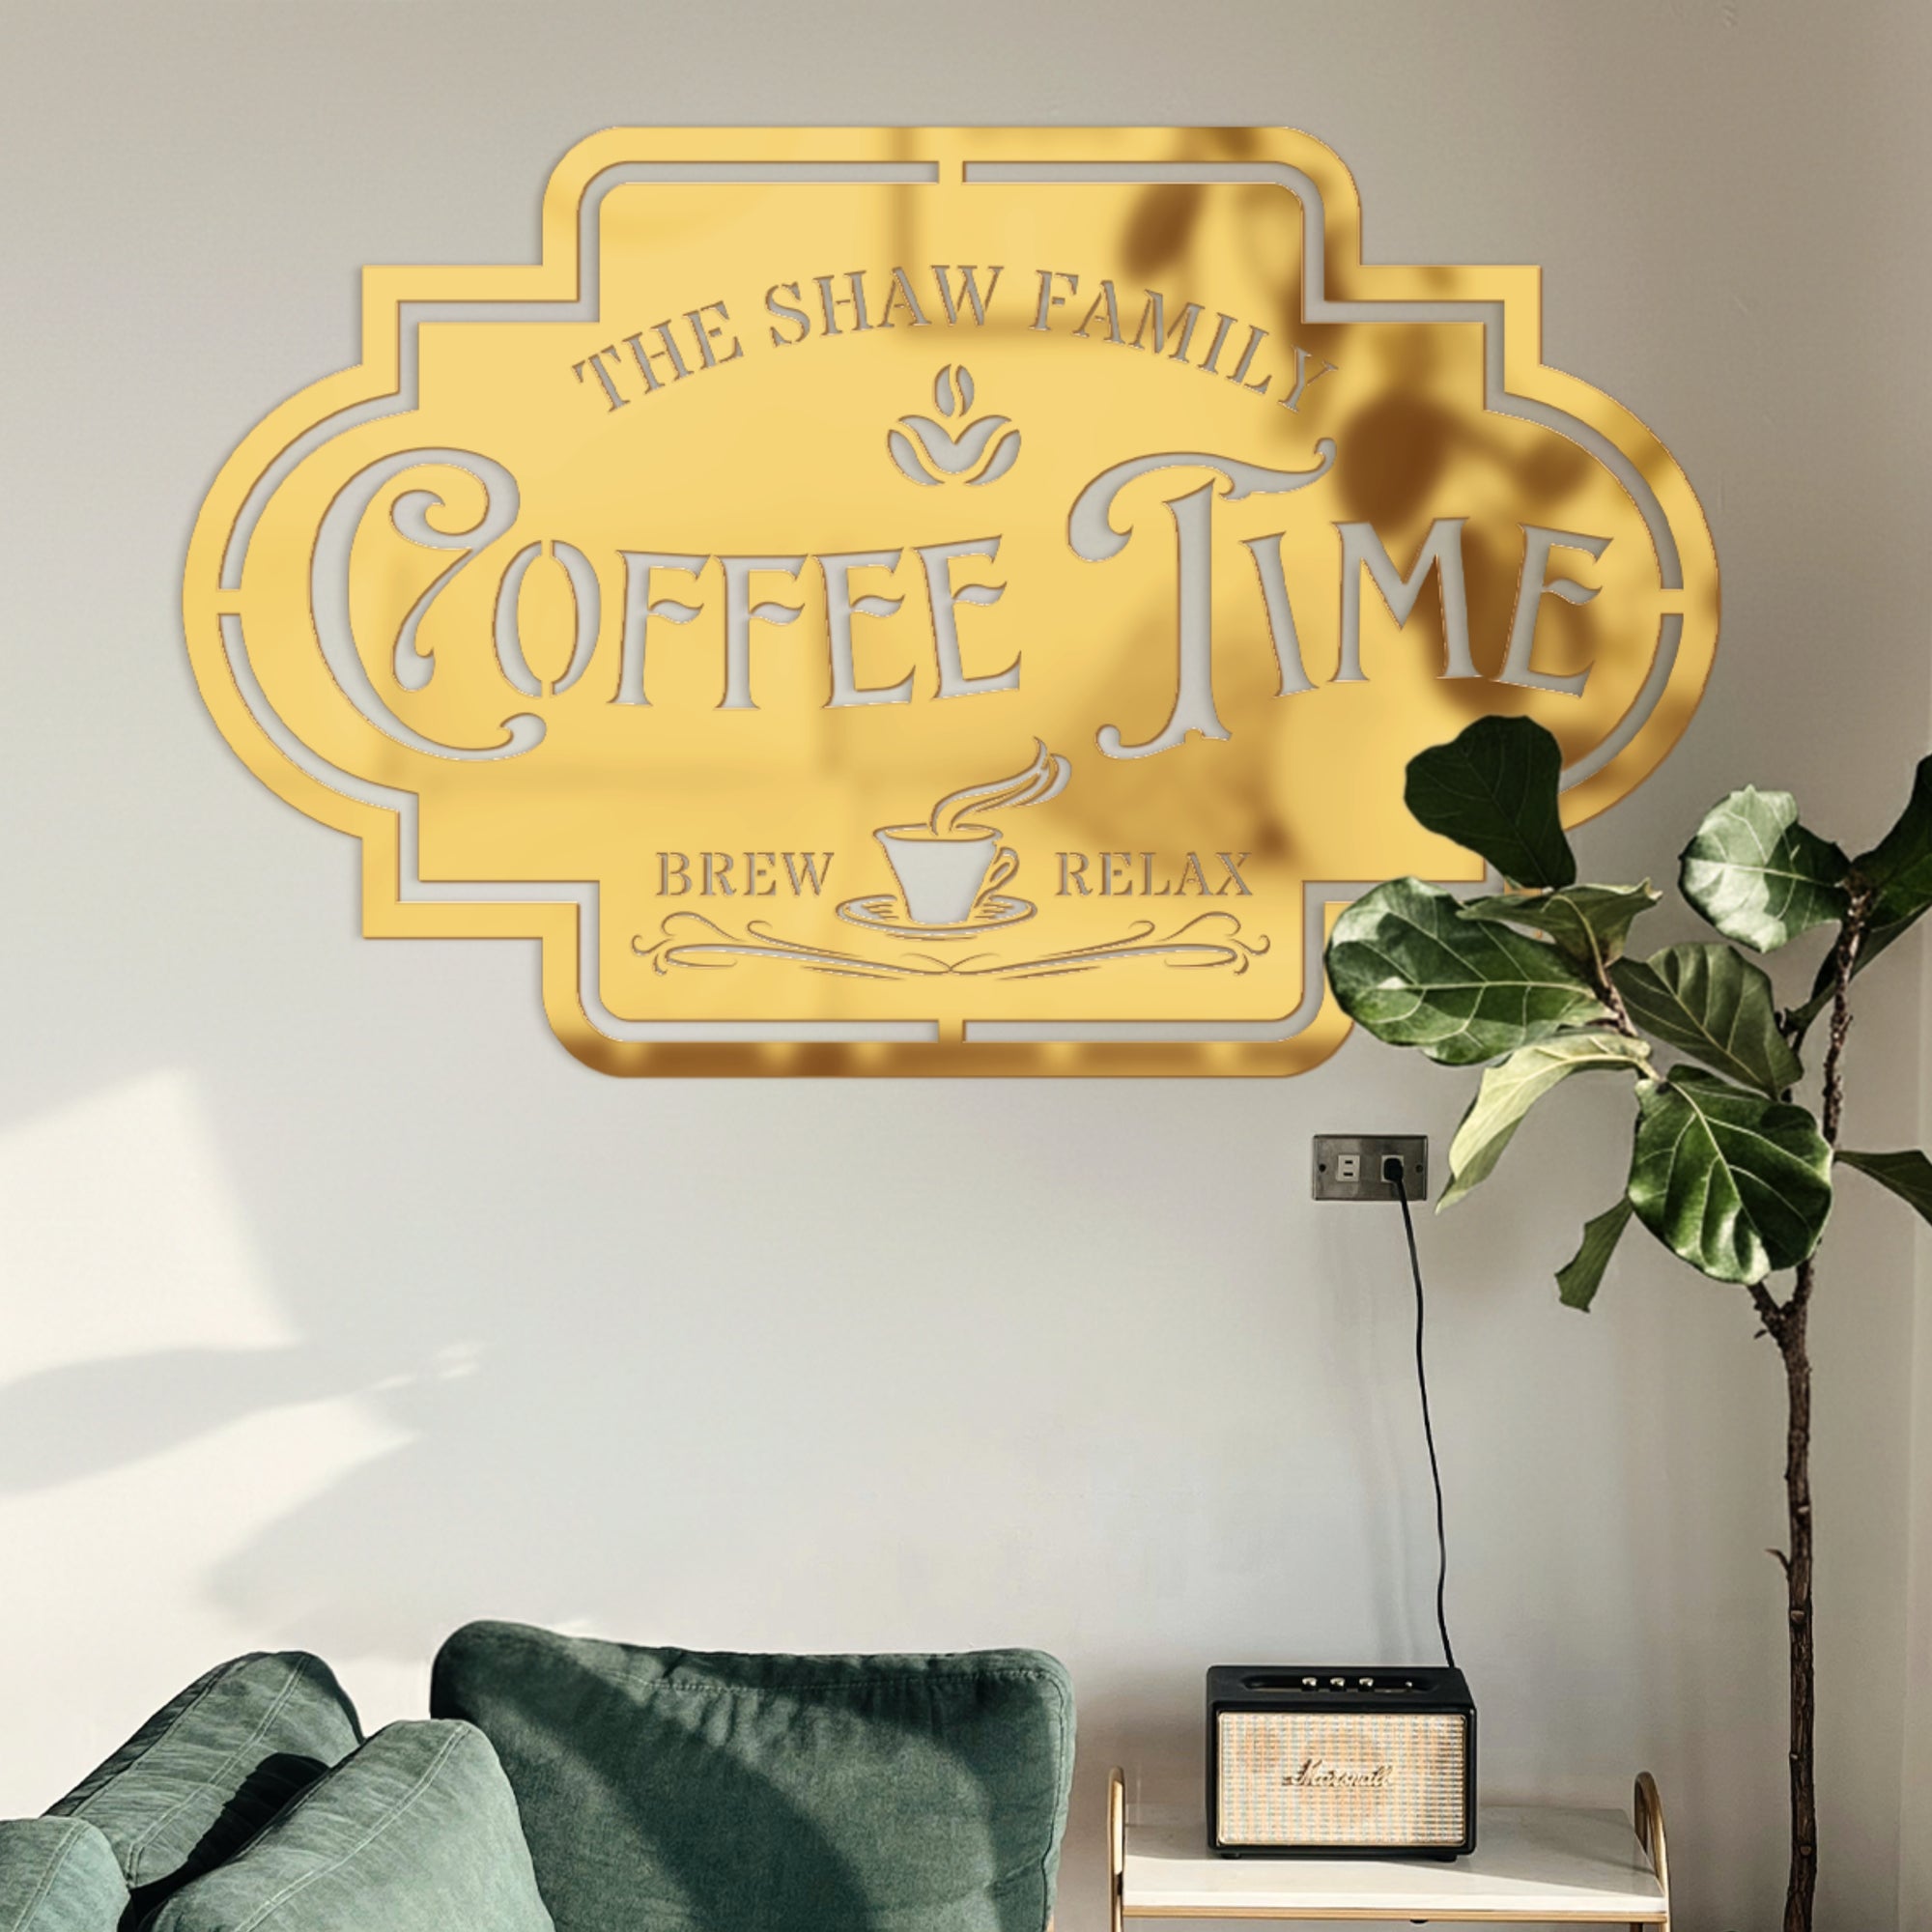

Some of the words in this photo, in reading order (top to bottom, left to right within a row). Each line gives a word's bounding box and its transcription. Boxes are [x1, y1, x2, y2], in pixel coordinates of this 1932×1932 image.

[571, 299, 744, 413] THE
[764, 264, 1005, 349] SHAW
[1028, 269, 1339, 413] FAMILY
[308, 446, 1022, 761] COFFEE
[1067, 437, 1614, 760] TIME
[655, 851, 835, 896] BREW
[1055, 851, 1253, 896] RELAX
